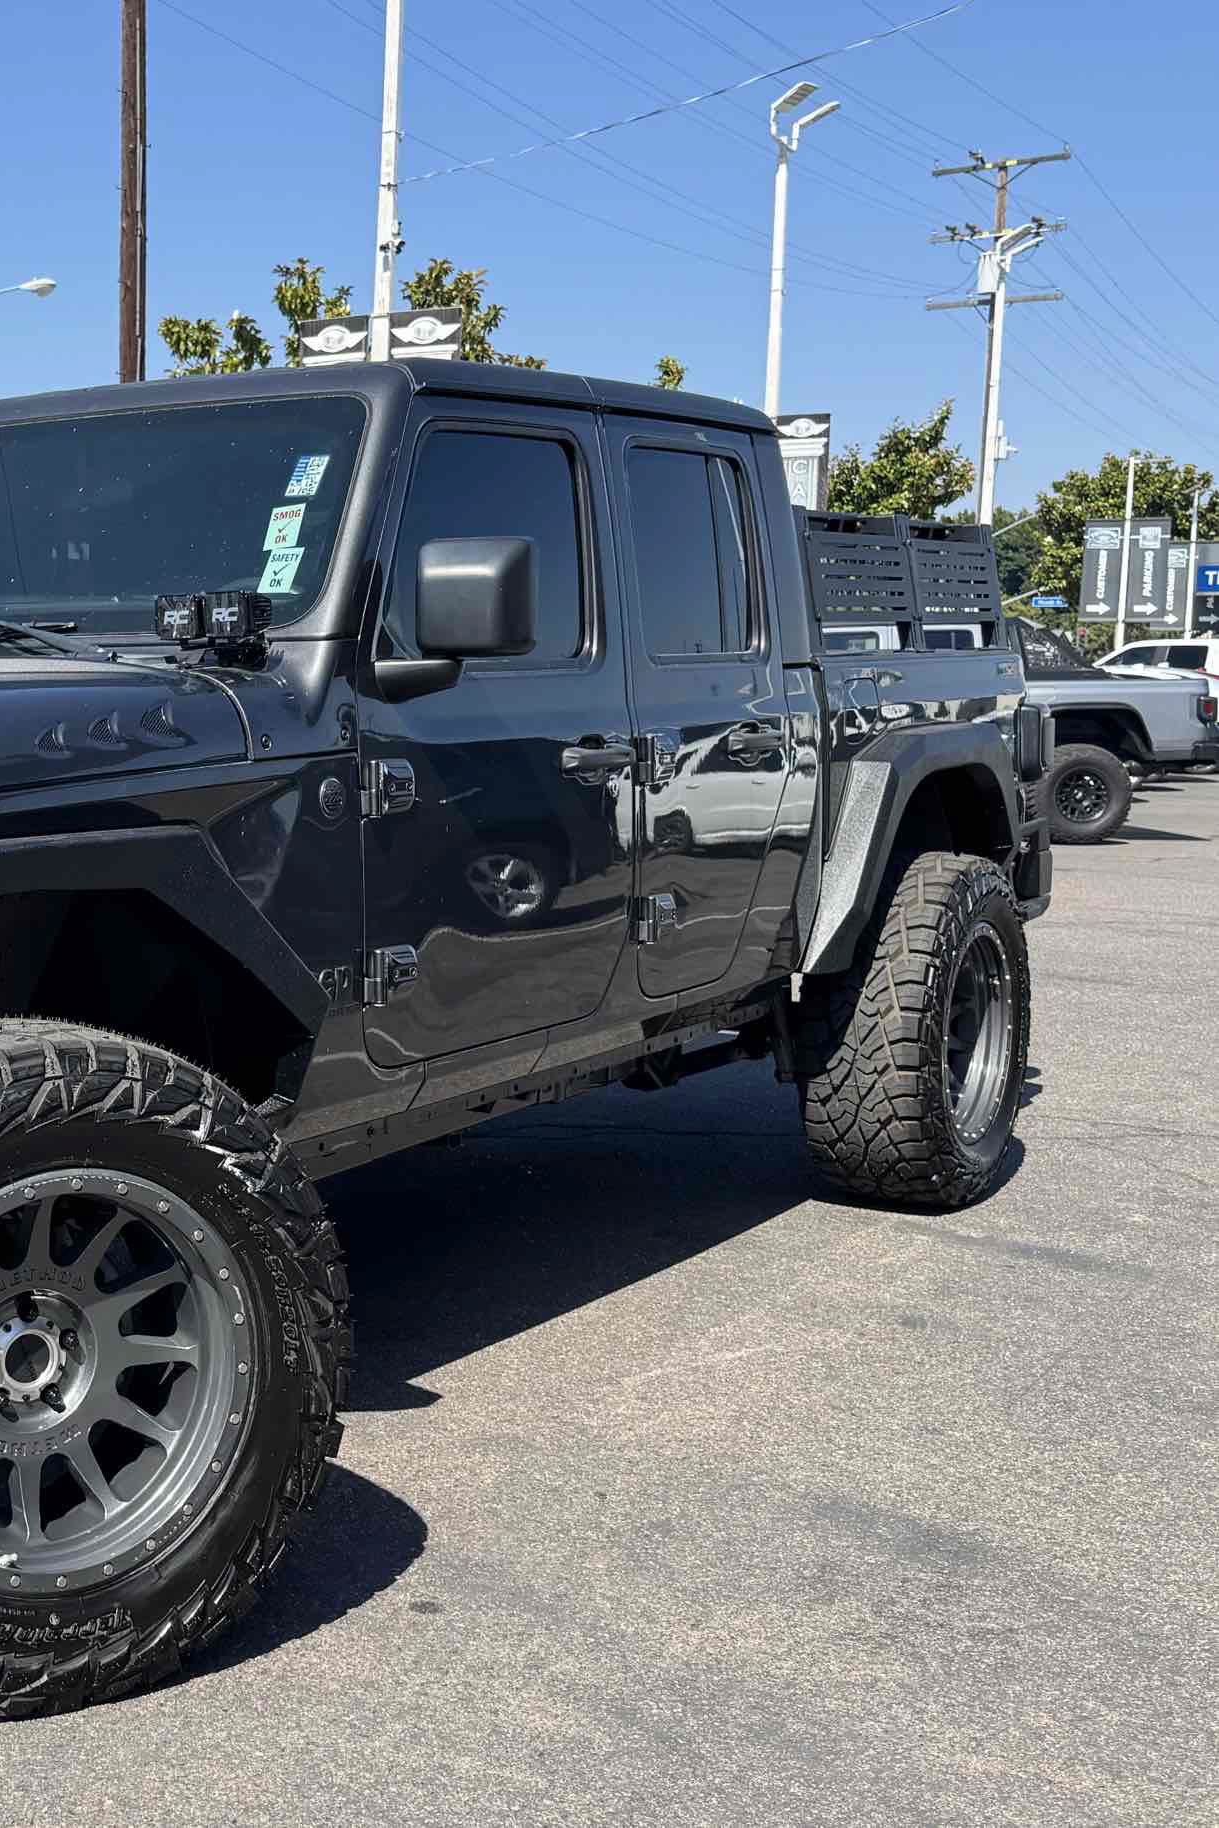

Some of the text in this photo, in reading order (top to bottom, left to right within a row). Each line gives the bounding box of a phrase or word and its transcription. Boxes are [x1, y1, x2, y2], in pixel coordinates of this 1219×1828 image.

[273, 508, 302, 521] SMOG
[275, 535, 287, 544] OK
[271, 552, 300, 563] SAFETY
[1142, 550, 1155, 598] PARKING
[269, 578, 283, 588] OK
[164, 610, 190, 625] RC
[212, 607, 239, 623] RC
